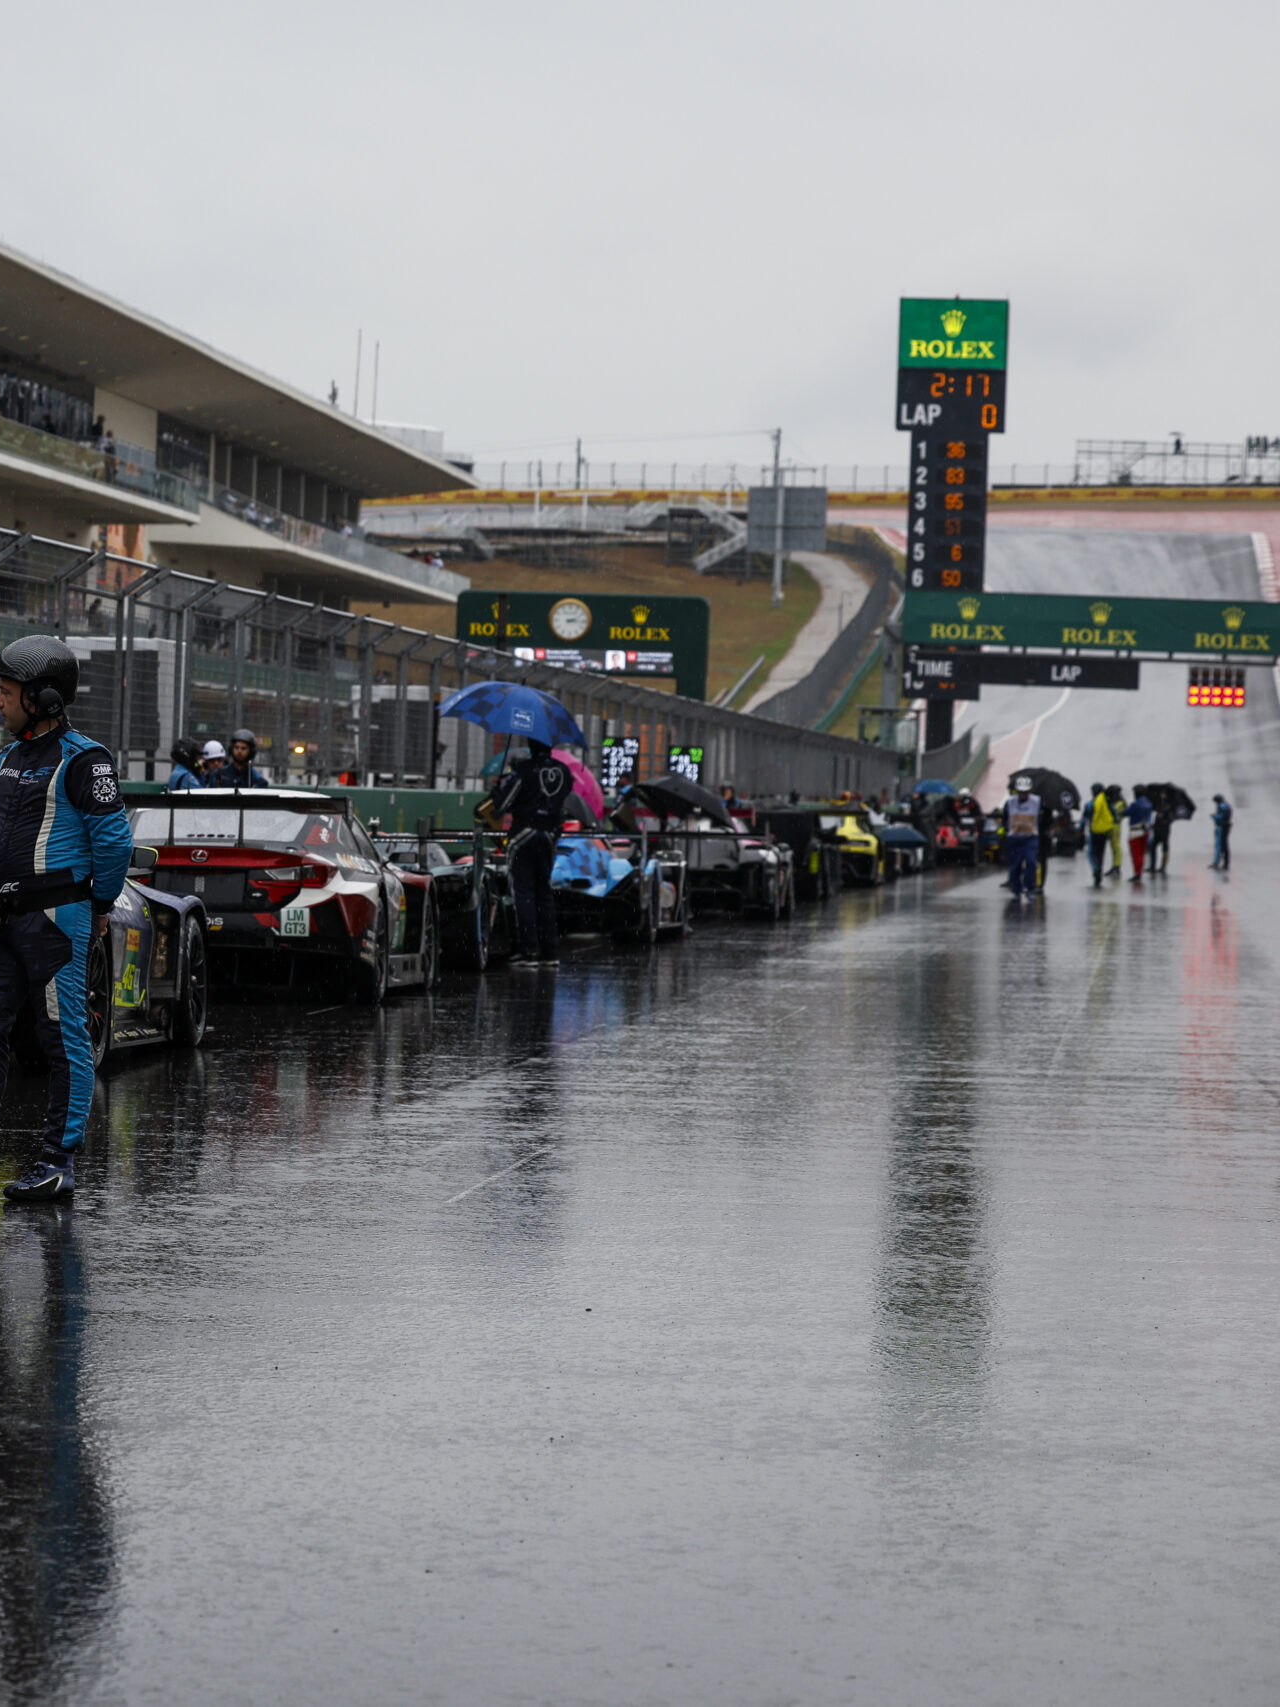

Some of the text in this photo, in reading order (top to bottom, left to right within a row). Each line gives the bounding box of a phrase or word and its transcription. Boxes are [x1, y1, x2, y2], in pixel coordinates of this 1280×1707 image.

[909, 339, 996, 360] ROLEX
[930, 372, 990, 398] 2:17
[900, 403, 997, 429] LAP 0
[916, 440, 927, 459] 1
[915, 466, 928, 485] 2
[914, 491, 927, 511] 3
[913, 517, 926, 536] 4
[912, 543, 962, 562] 5 6
[911, 568, 924, 587] 6
[469, 622, 531, 637] ROEX
[609, 626, 671, 642] ROLEX
[930, 622, 1006, 641] ROLEX
[1062, 627, 1138, 646] ROLEX
[1194, 632, 1271, 651] ROLEX
[916, 659, 954, 678] TIME
[1051, 663, 1083, 683] LAP
[0, 766, 21, 778] OFFICIAL
[92, 764, 112, 775] OMP
[286, 909, 305, 921] LM
[283, 923, 306, 935] GT3
